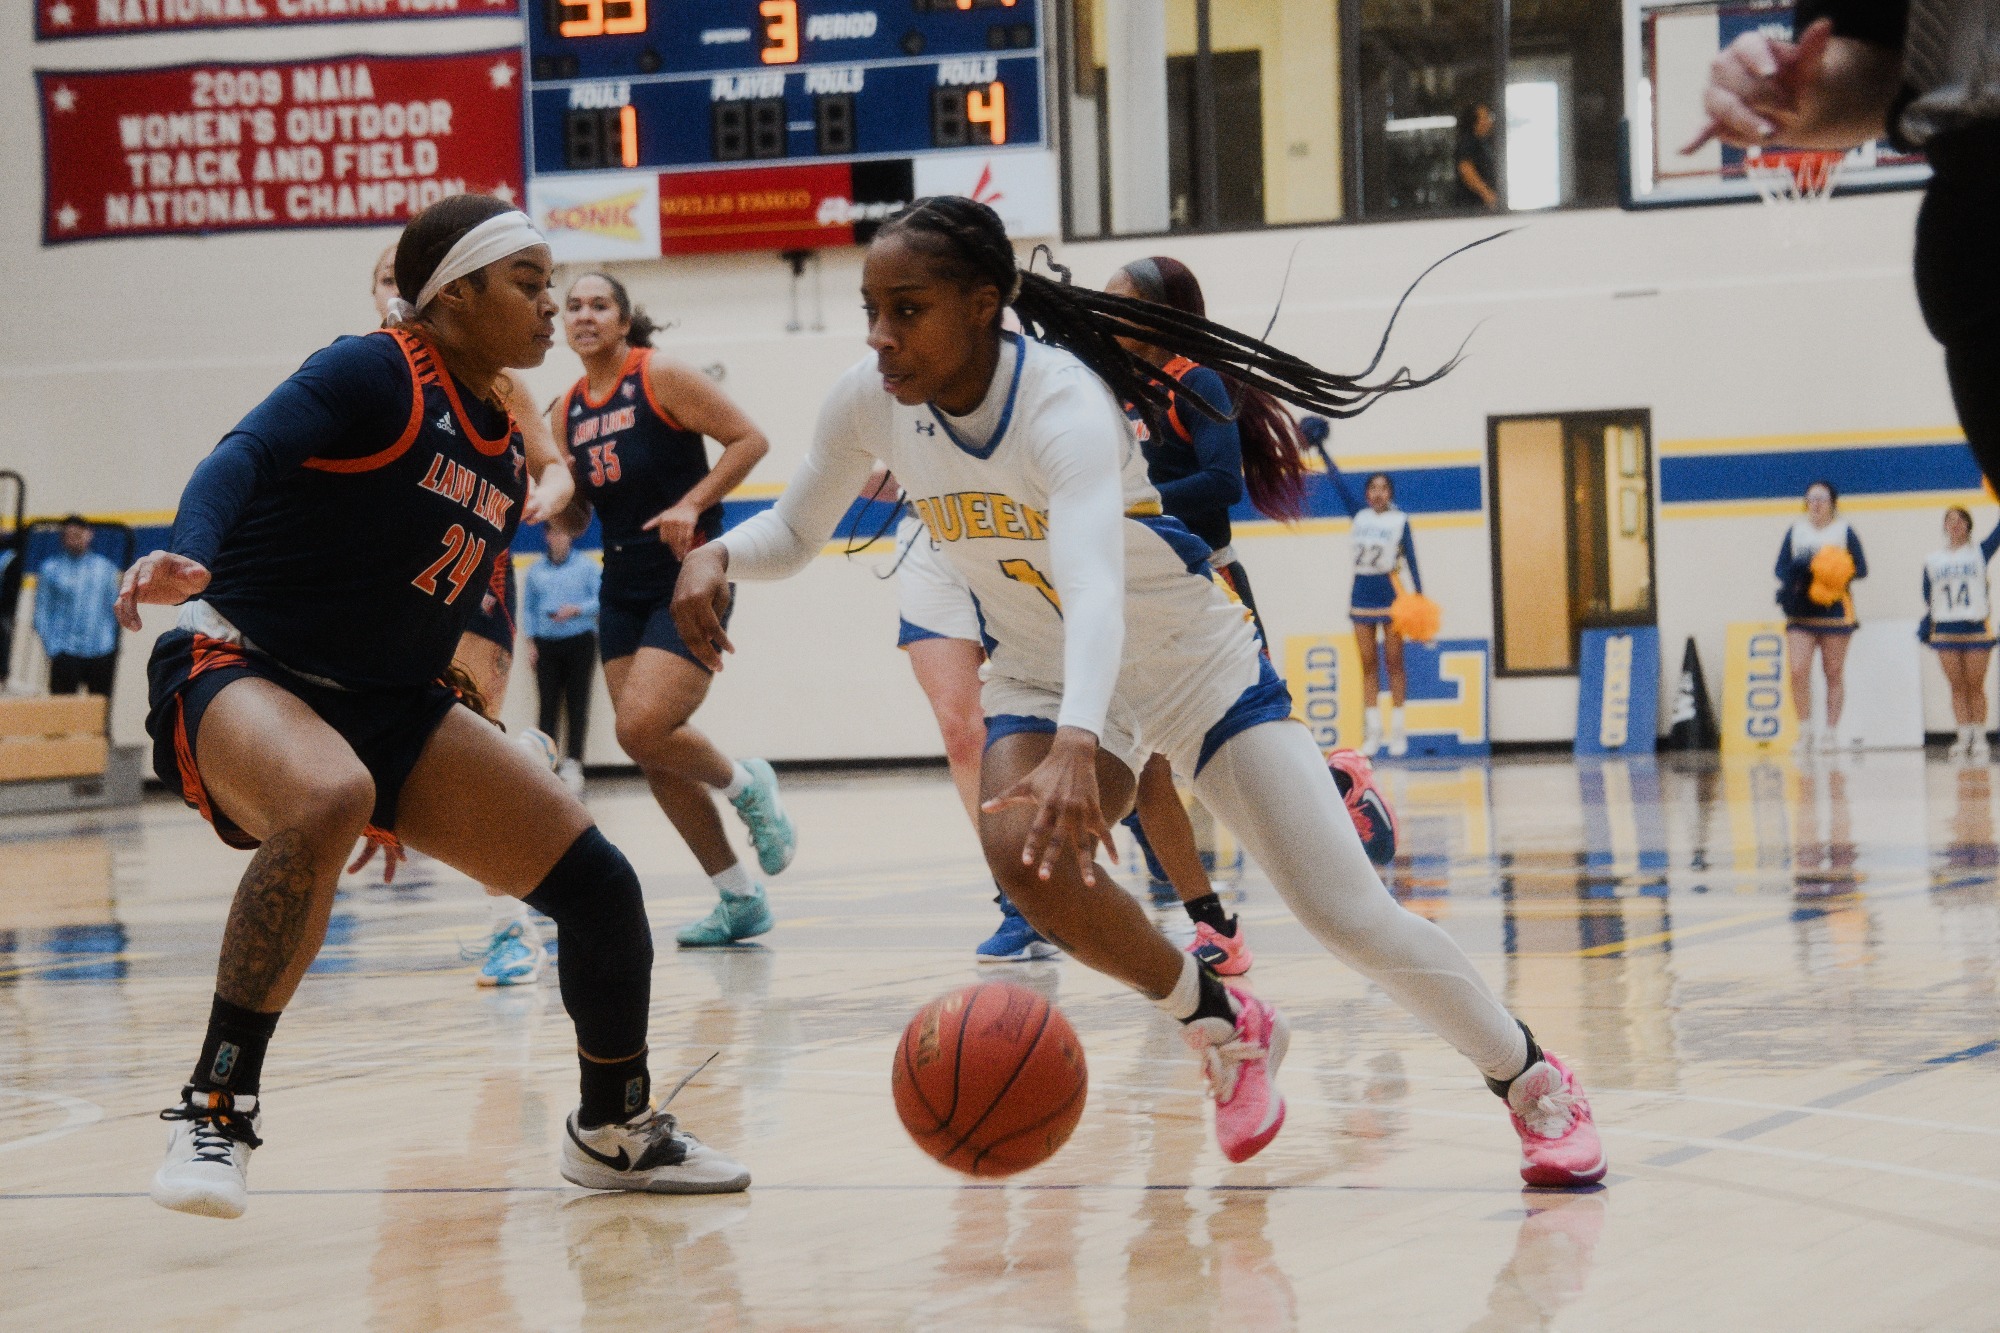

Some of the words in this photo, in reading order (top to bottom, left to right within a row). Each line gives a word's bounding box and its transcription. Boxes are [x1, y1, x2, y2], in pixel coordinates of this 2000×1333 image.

[760, 0, 798, 63] 3
[806, 11, 877, 41] PERIOD
[191, 70, 282, 107] 2009
[292, 65, 375, 101] NAIA
[710, 71, 786, 101] PLAYER
[118, 109, 276, 150] WOMEN'S
[286, 100, 453, 143] OUTDOOR
[620, 104, 638, 168] 1
[967, 81, 1006, 145] 4
[125, 150, 242, 187] TRACK
[253, 145, 325, 184] AND
[332, 140, 439, 178] FIELD
[105, 188, 276, 227] NATIONAL
[545, 202, 637, 232] SONIC
[417, 452, 477, 508] LADY
[588, 440, 622, 487] 35
[411, 523, 486, 606] 24
[1305, 646, 1339, 748] GOLD
[1746, 633, 1783, 740] GOLD
